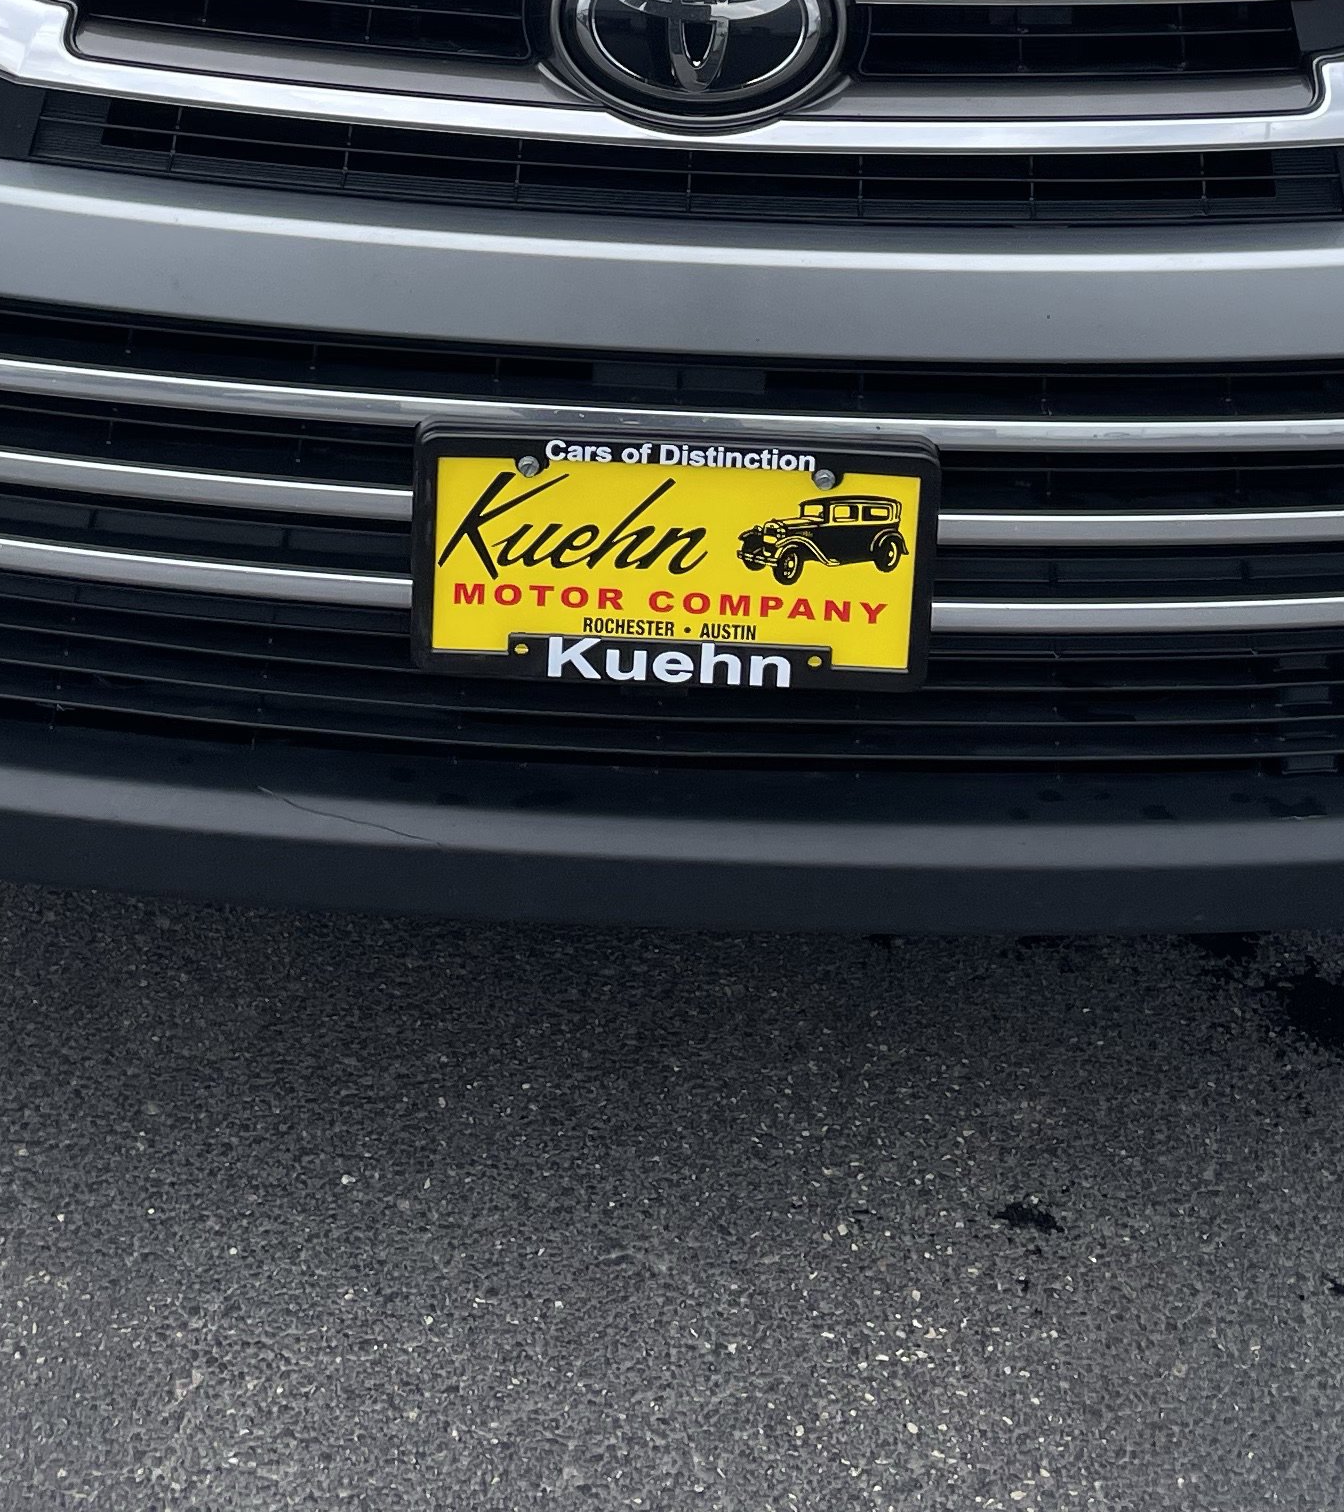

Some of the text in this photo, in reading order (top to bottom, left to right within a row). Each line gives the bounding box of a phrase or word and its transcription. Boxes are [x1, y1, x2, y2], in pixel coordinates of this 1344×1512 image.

[545, 439, 816, 473] Cars of Distinction
[437, 470, 710, 580] Kuehn
[453, 583, 888, 625] MOTOR COMPANY
[583, 617, 758, 641] ROCHESTER AUSTIN
[547, 636, 791, 688] Kuehn
